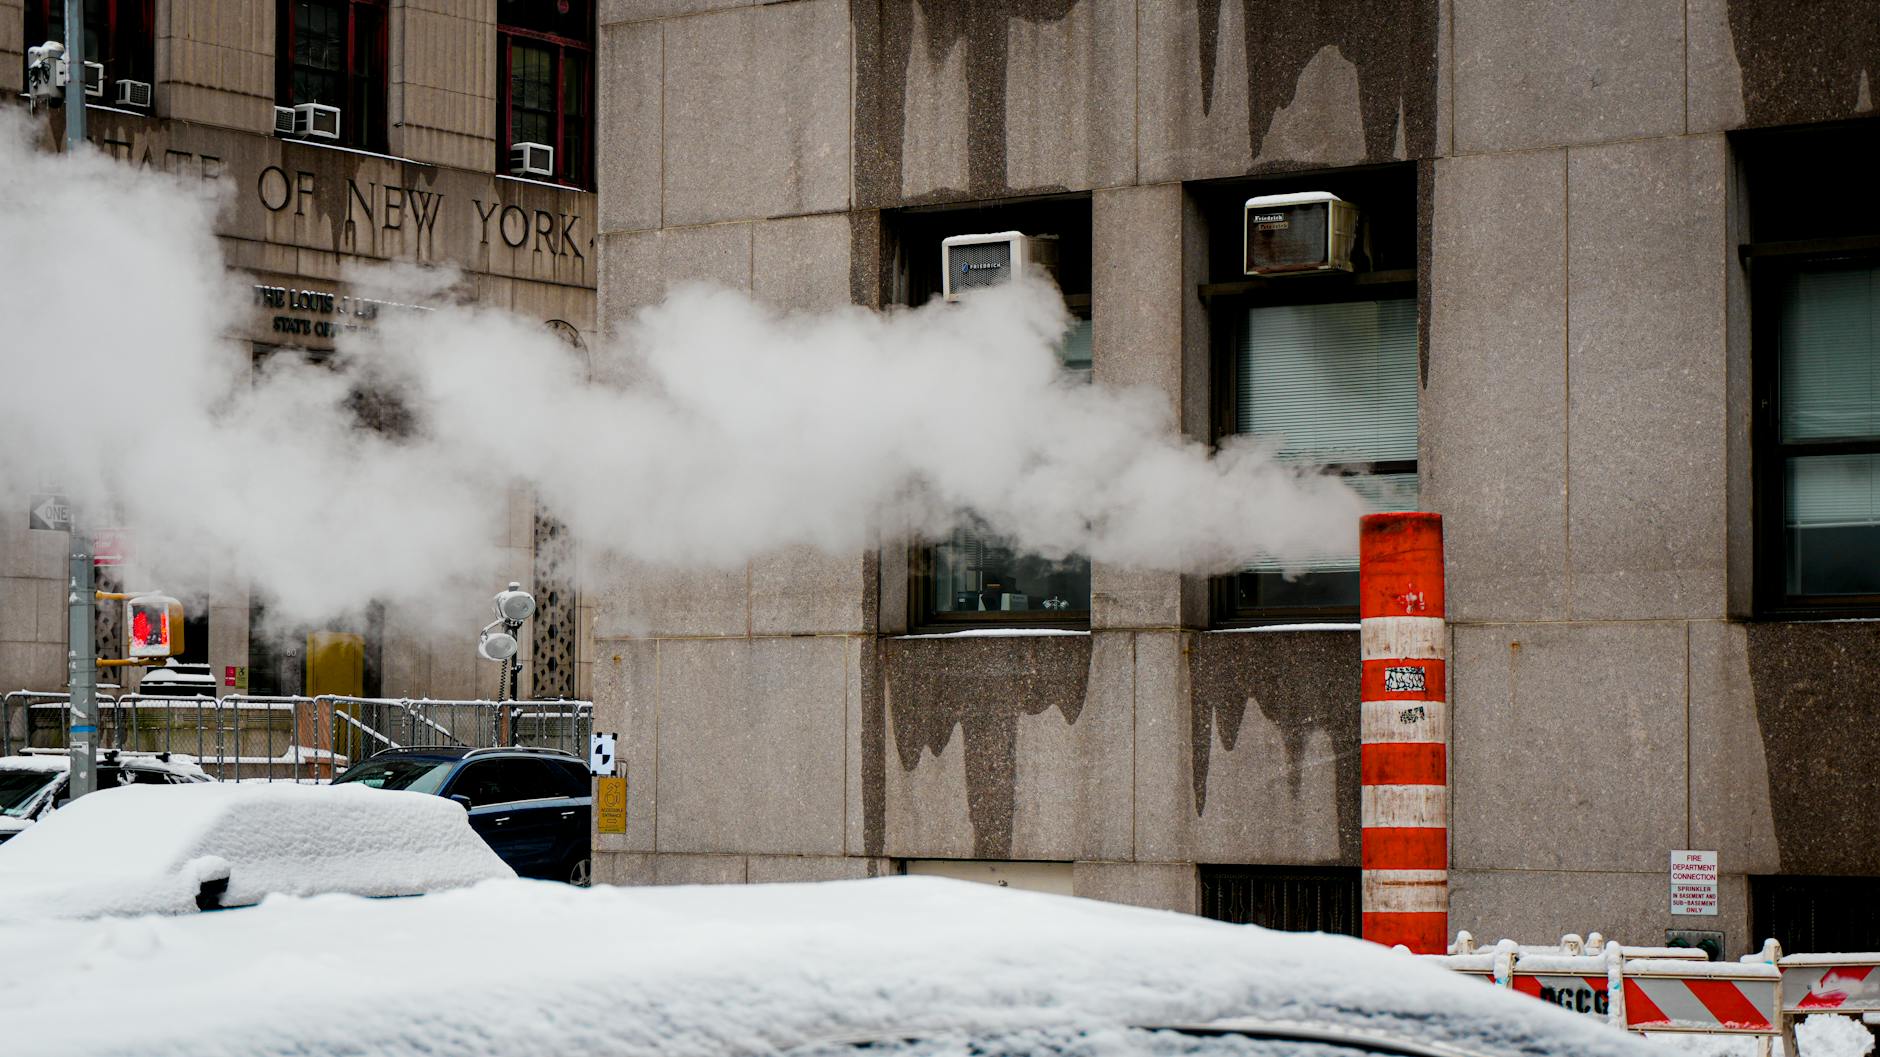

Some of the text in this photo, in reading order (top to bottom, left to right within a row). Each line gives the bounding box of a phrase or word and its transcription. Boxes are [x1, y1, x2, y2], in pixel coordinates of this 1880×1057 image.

[257, 165, 315, 216] OF
[345, 178, 445, 233] NEW
[472, 200, 585, 258] YORK
[1254, 214, 1284, 222] Friedrich
[969, 262, 1001, 270] FRIEDRICH
[289, 288, 335, 315] LOUIS
[273, 316, 312, 336] STATE
[44, 505, 68, 521] ONE
[1686, 854, 1703, 862] FIRE
[1672, 863, 1716, 872] DEPARTMENT
[1672, 873, 1716, 881] CONNECTION
